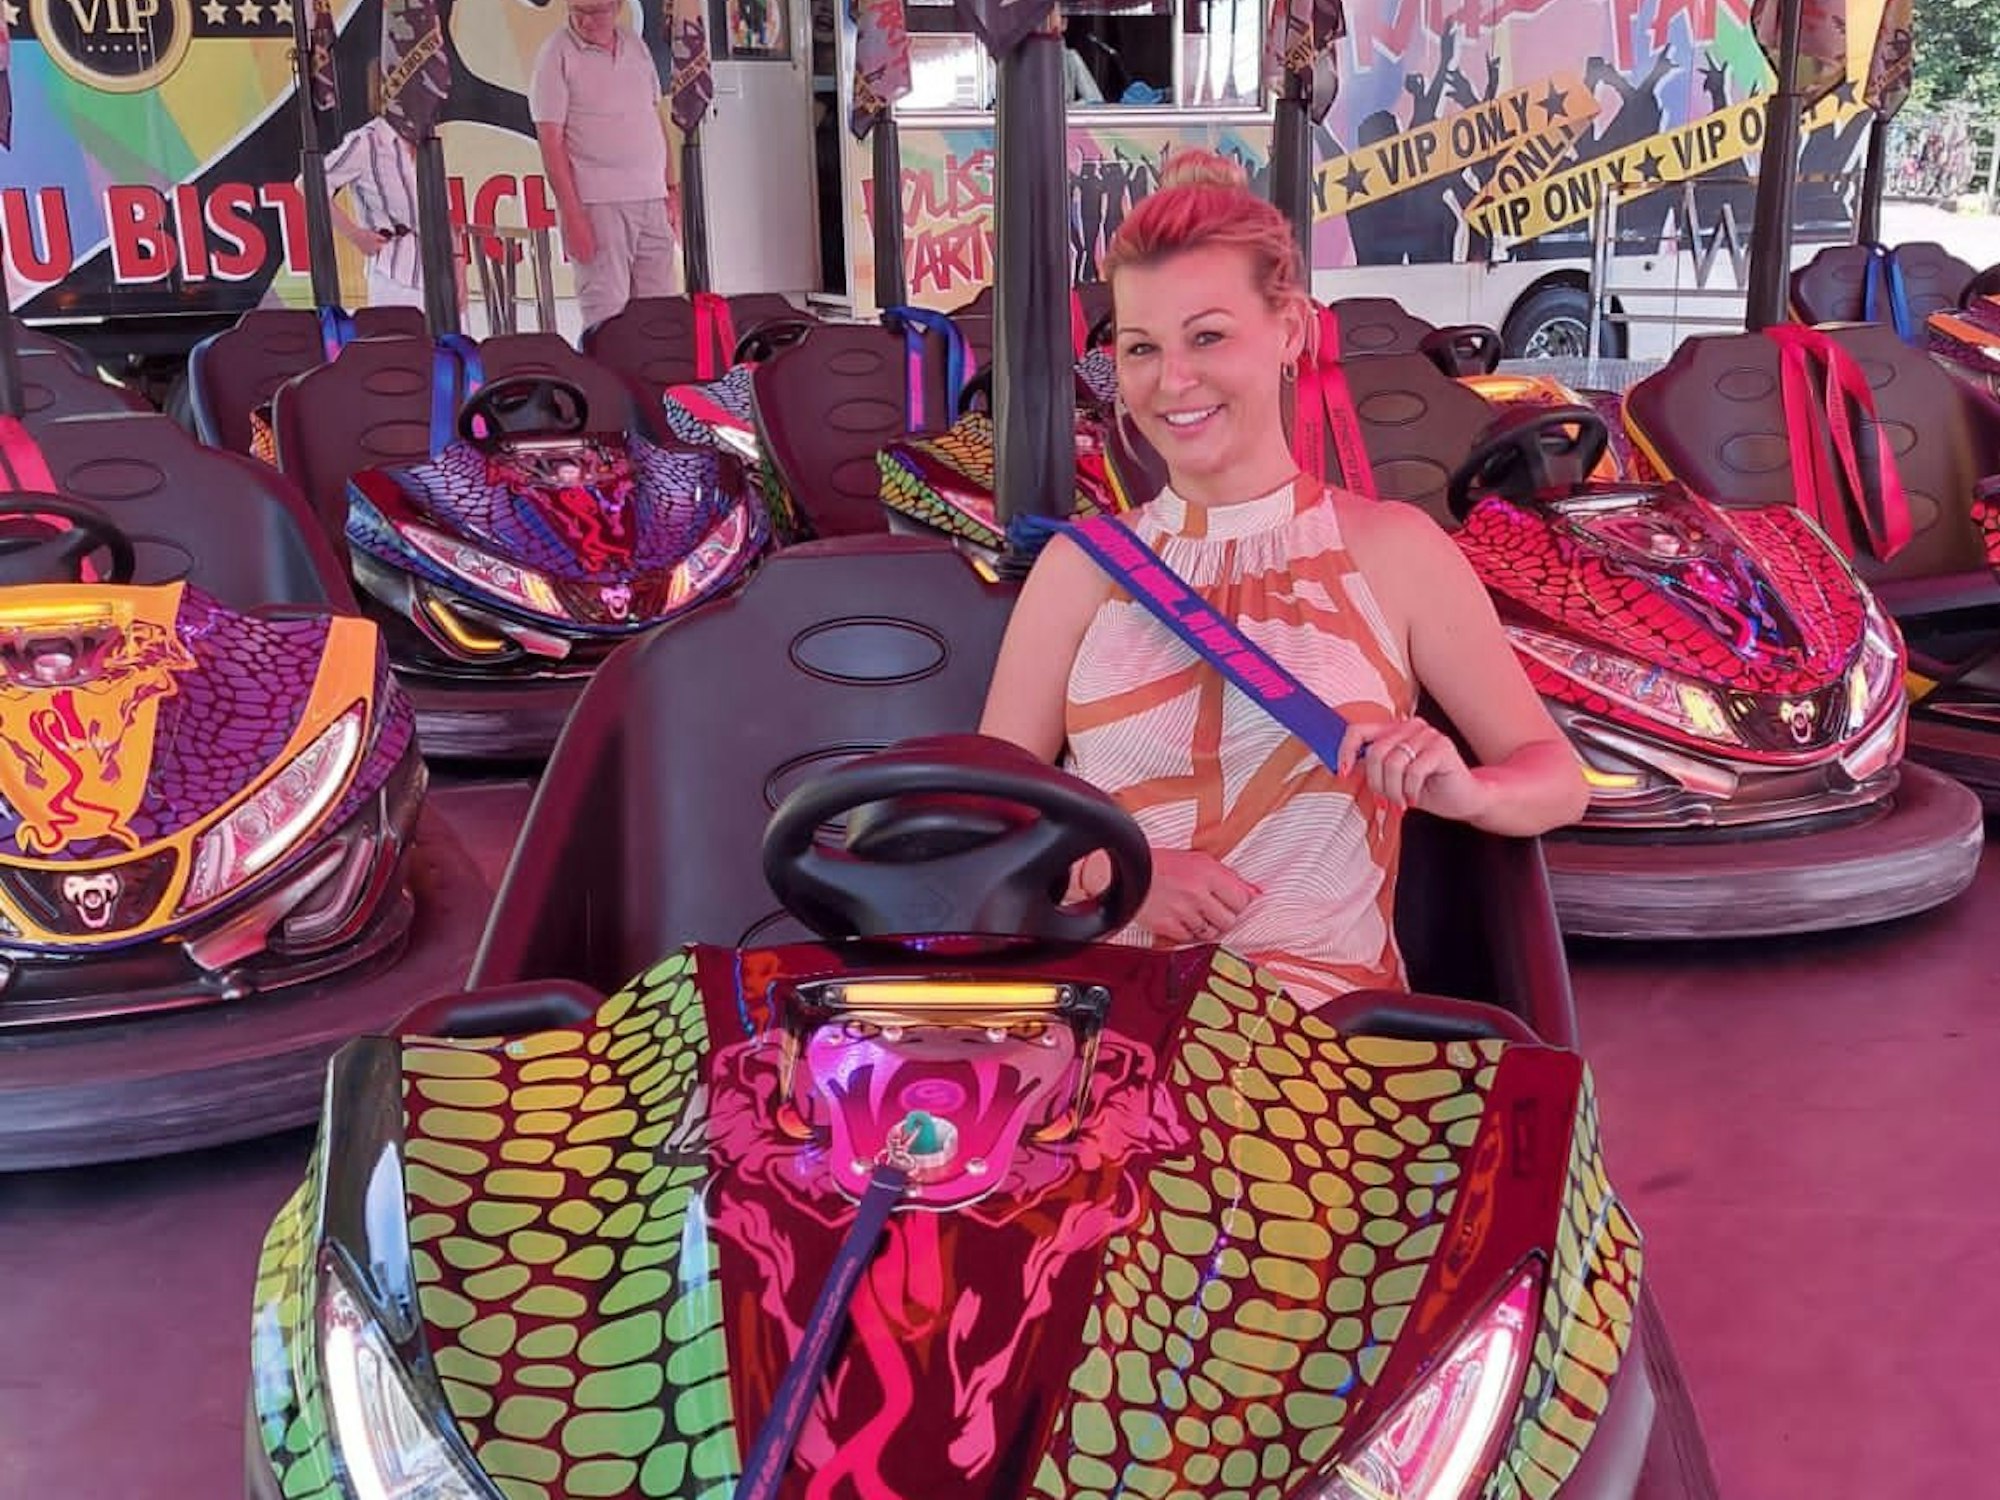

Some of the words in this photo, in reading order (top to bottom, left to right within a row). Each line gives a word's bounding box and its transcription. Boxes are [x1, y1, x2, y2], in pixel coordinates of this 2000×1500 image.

[67, 0, 159, 34] VIP
[1376, 132, 1437, 186] VIP
[1452, 91, 1529, 159] ONLY
[1671, 119, 1728, 171] VIP
[104, 181, 313, 284] BIST
